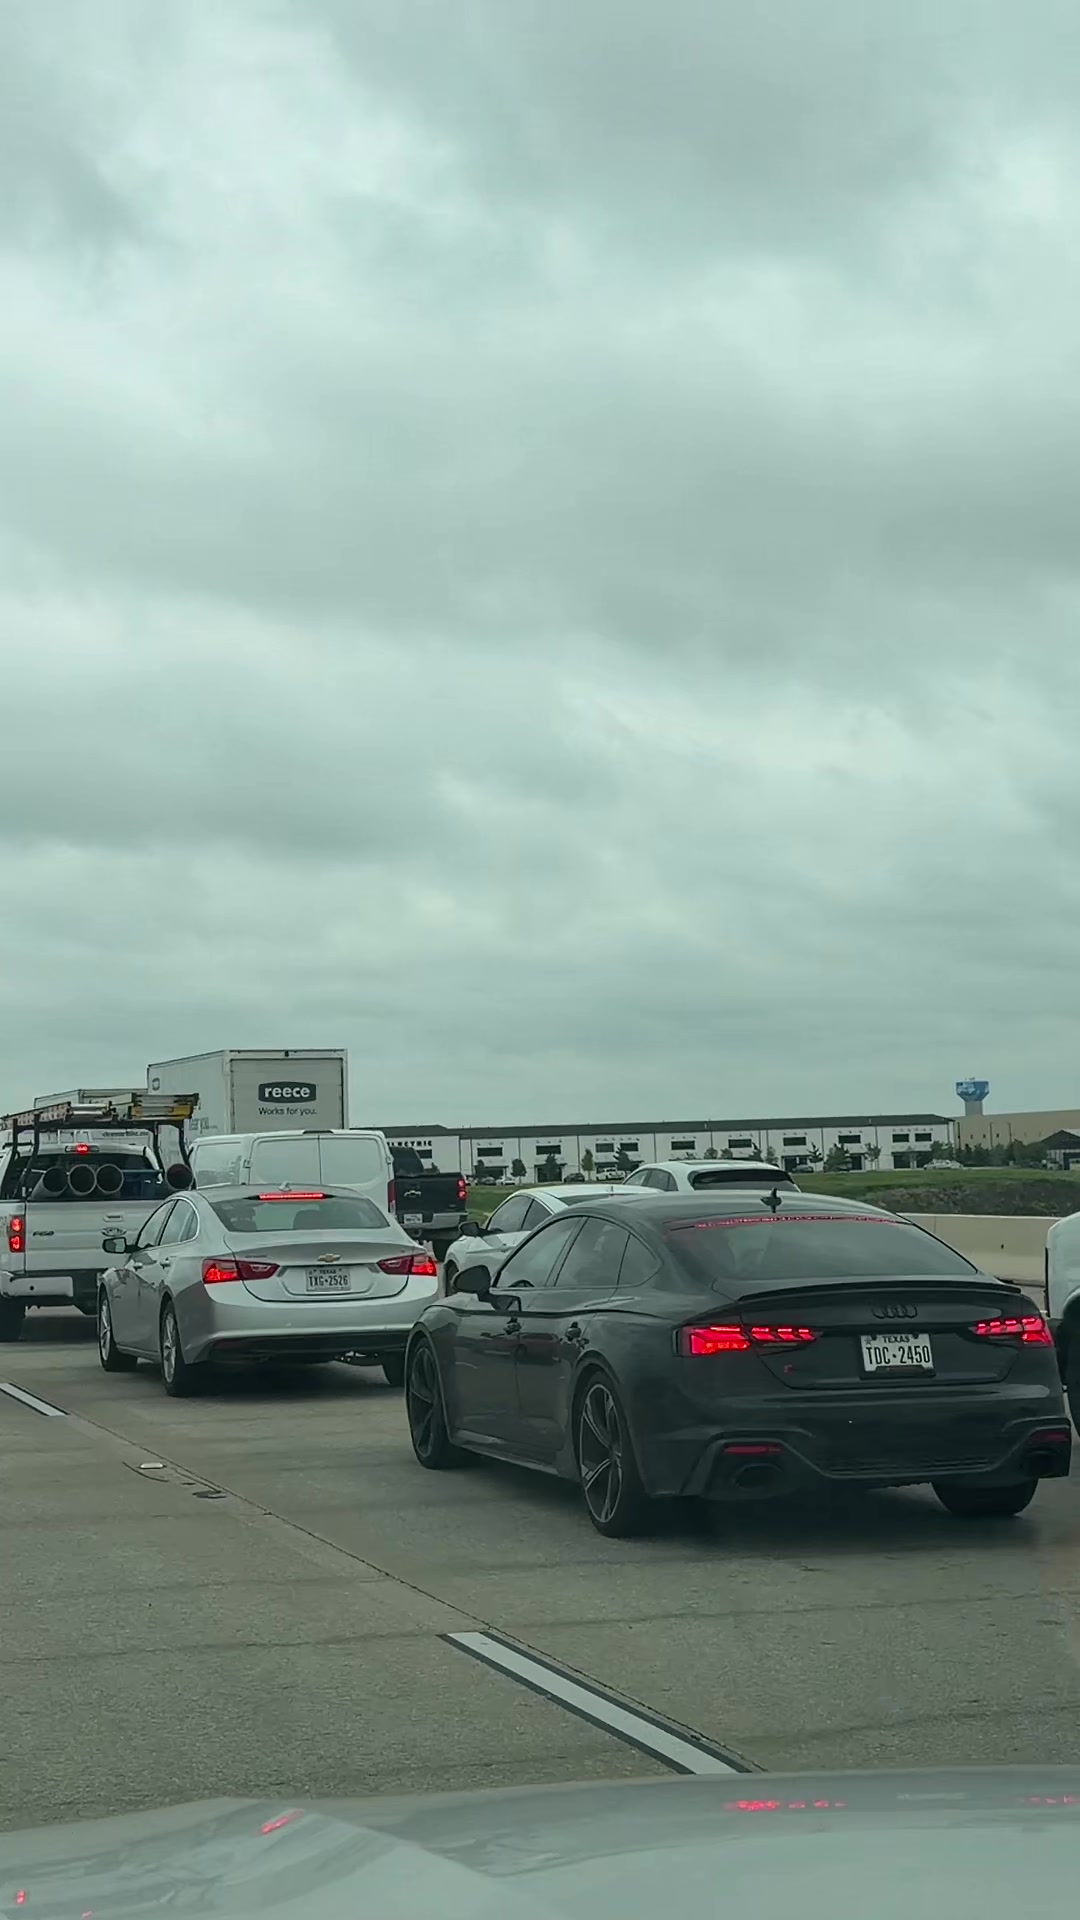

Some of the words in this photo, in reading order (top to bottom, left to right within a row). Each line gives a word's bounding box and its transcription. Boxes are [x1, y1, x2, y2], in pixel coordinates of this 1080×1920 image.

[264, 1087, 310, 1098] reece
[258, 1107, 284, 1115] Works
[286, 1107, 298, 1115] for
[299, 1108, 317, 1116] you.
[882, 1335, 910, 1343] TEXAS
